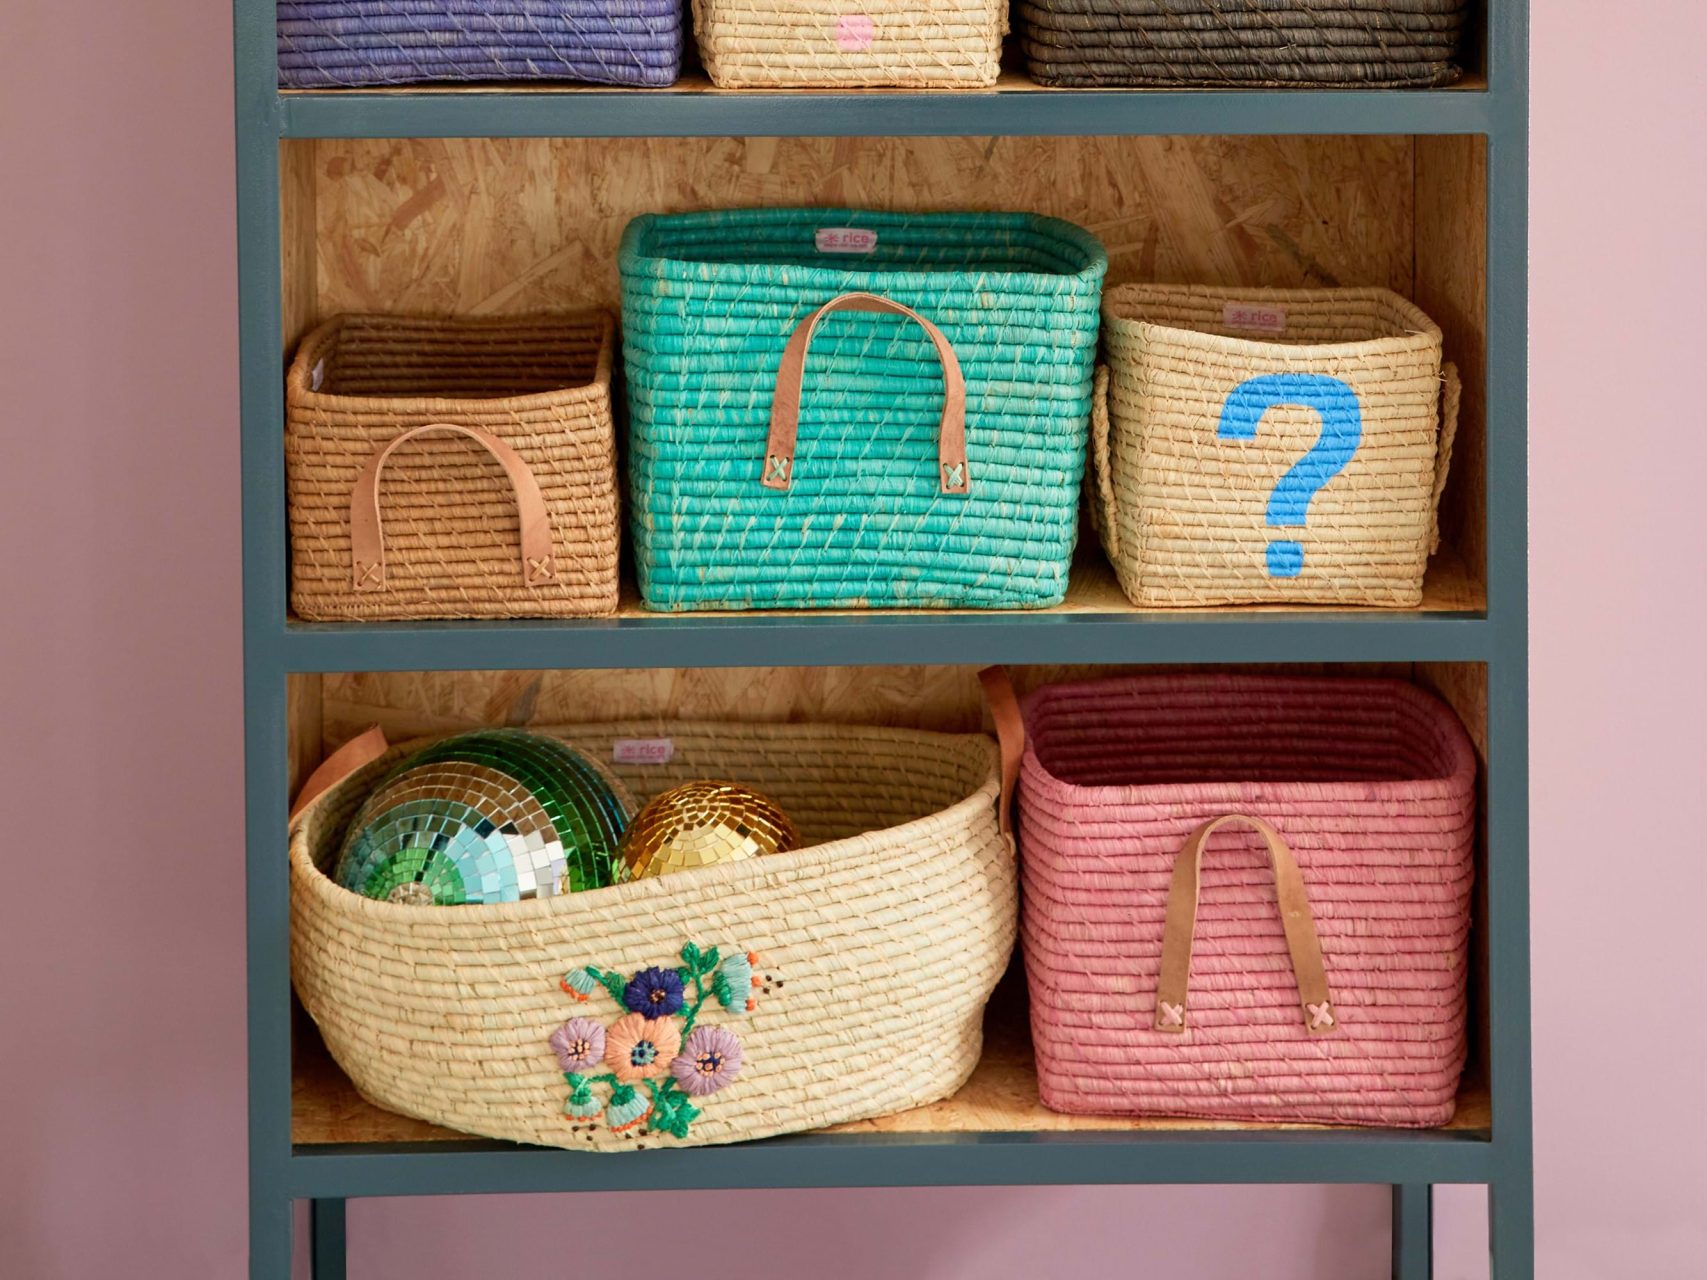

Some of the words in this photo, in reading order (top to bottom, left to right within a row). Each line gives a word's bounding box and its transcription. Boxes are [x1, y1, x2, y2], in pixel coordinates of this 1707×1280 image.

[843, 232, 868, 244] rice
[1251, 311, 1278, 322] rice
[640, 744, 665, 754] rice
